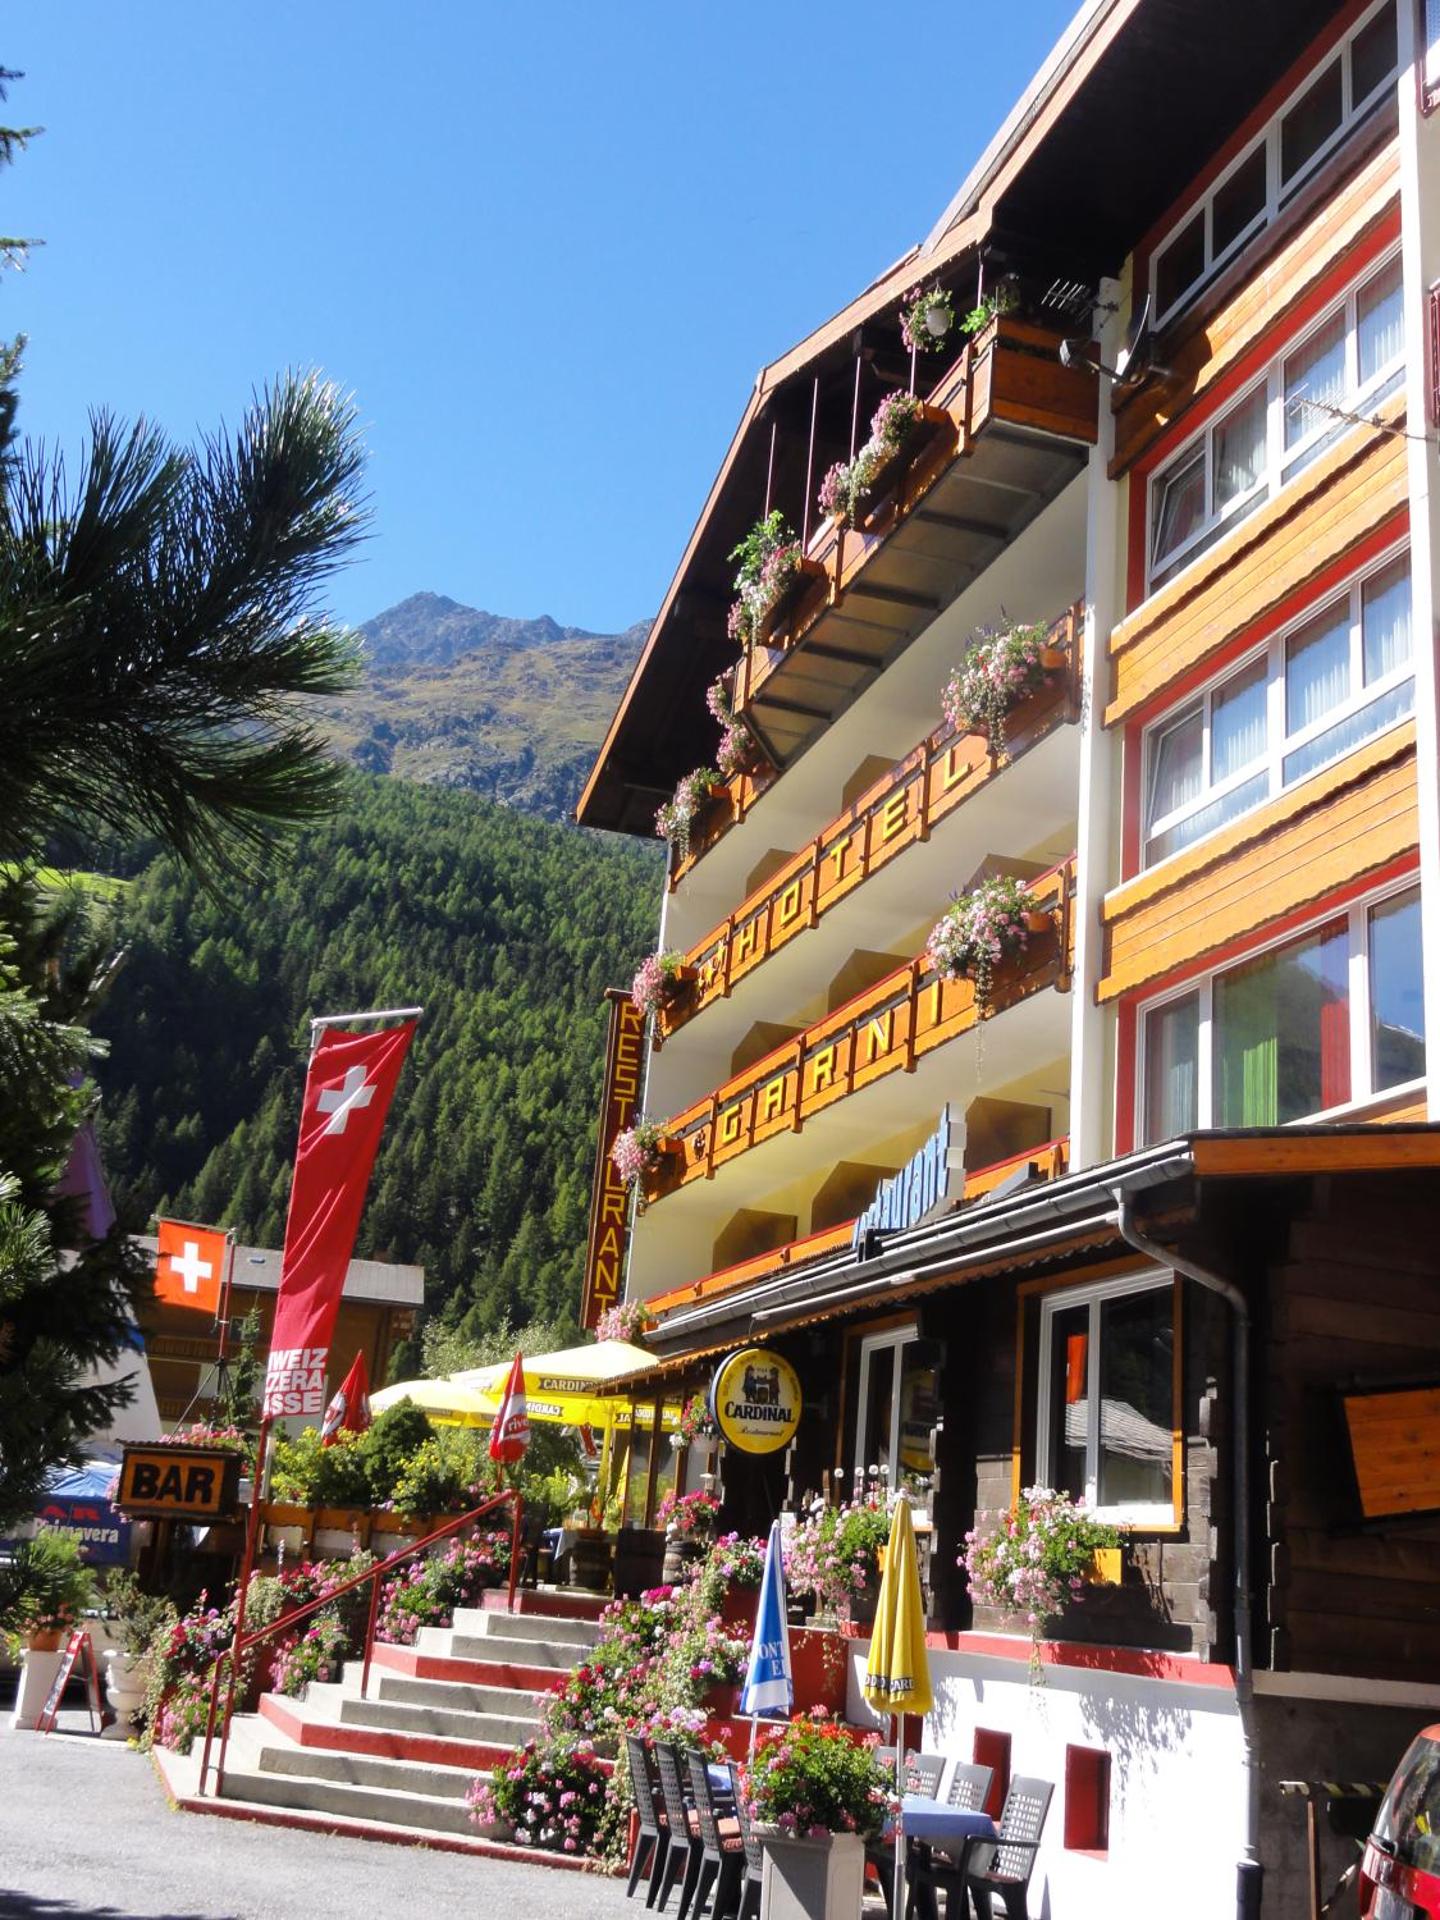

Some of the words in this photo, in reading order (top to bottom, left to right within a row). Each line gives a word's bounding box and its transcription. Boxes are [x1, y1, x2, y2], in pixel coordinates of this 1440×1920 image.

[739, 749, 968, 961] HOTEL
[721, 980, 938, 1143] GARNI
[594, 1001, 642, 1317] RESTURANT
[130, 1463, 215, 1504] BAR
[724, 1402, 796, 1423] CARDINAL
